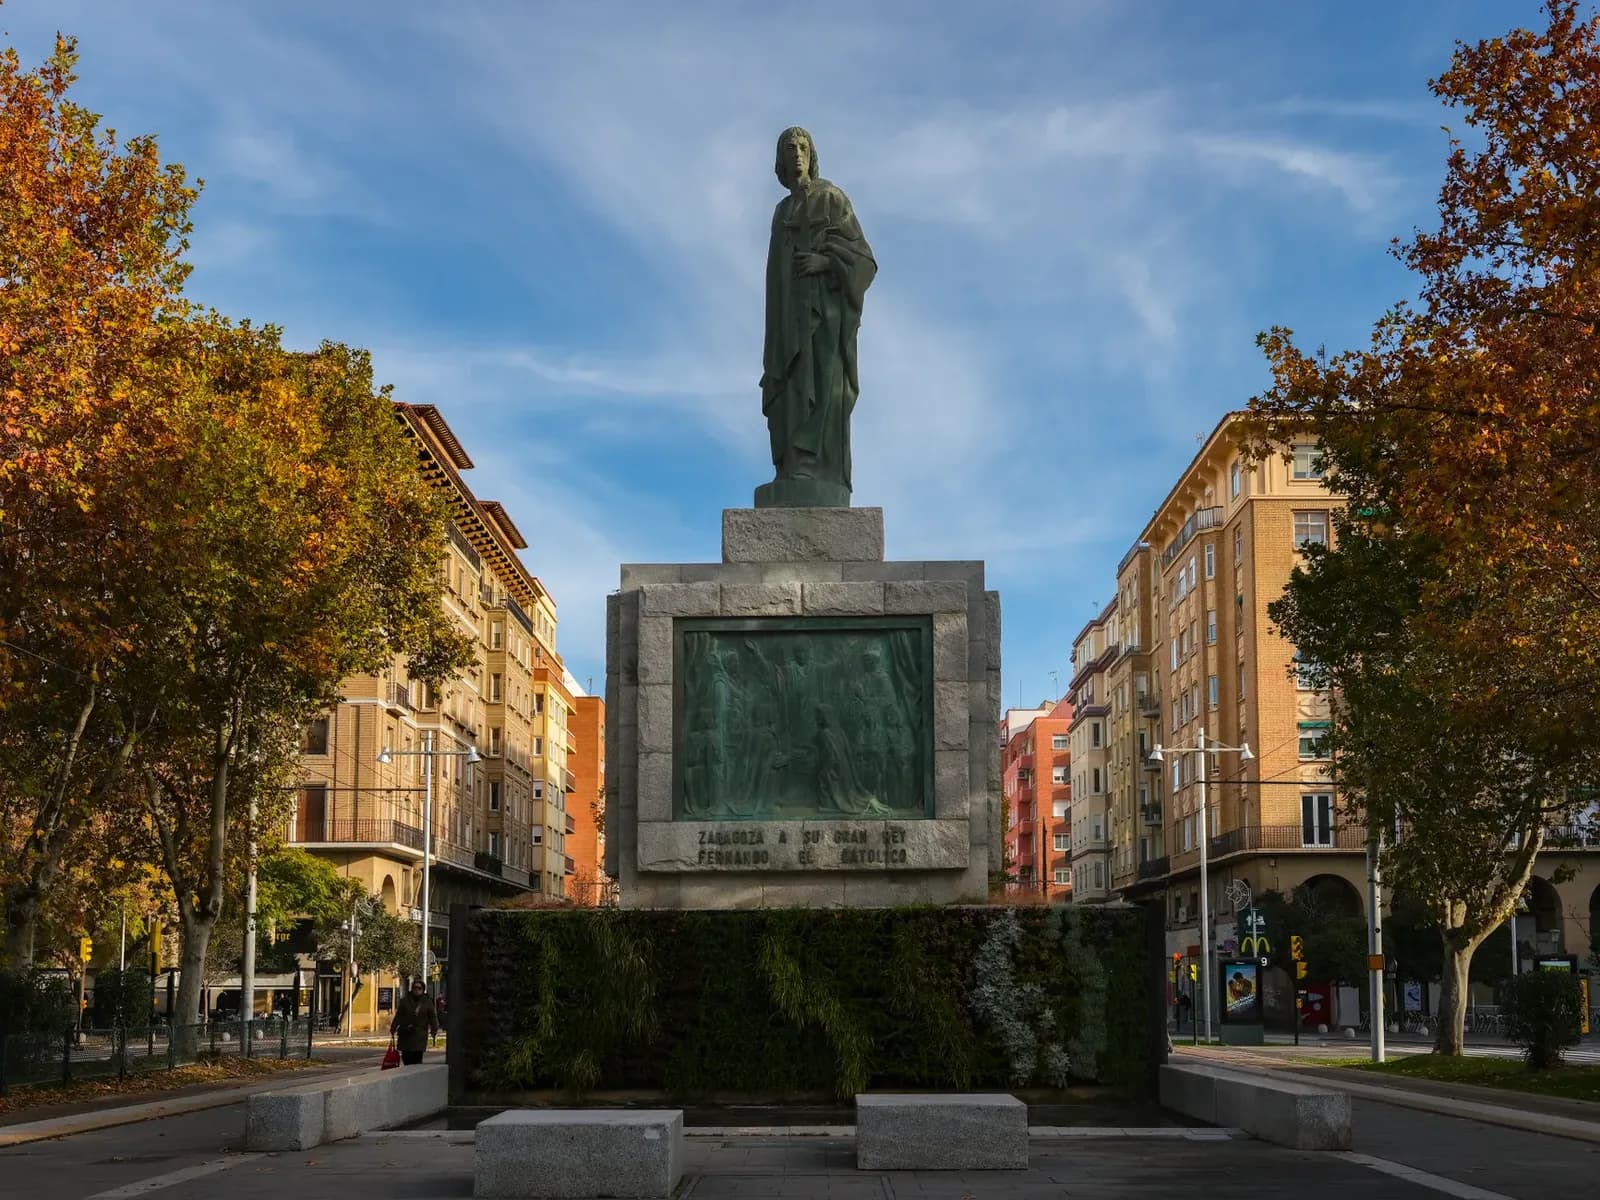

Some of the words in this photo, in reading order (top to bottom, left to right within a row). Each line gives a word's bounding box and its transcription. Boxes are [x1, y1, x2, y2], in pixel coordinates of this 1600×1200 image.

[698, 831, 764, 845] ZARAGOZA
[778, 830, 787, 844] A
[804, 830, 820, 844] SU
[834, 830, 867, 844] GRAN
[881, 830, 906, 844] REY
[698, 849, 769, 865] FERNANDO
[798, 850, 813, 864] EL
[1260, 957, 1268, 967] 9
